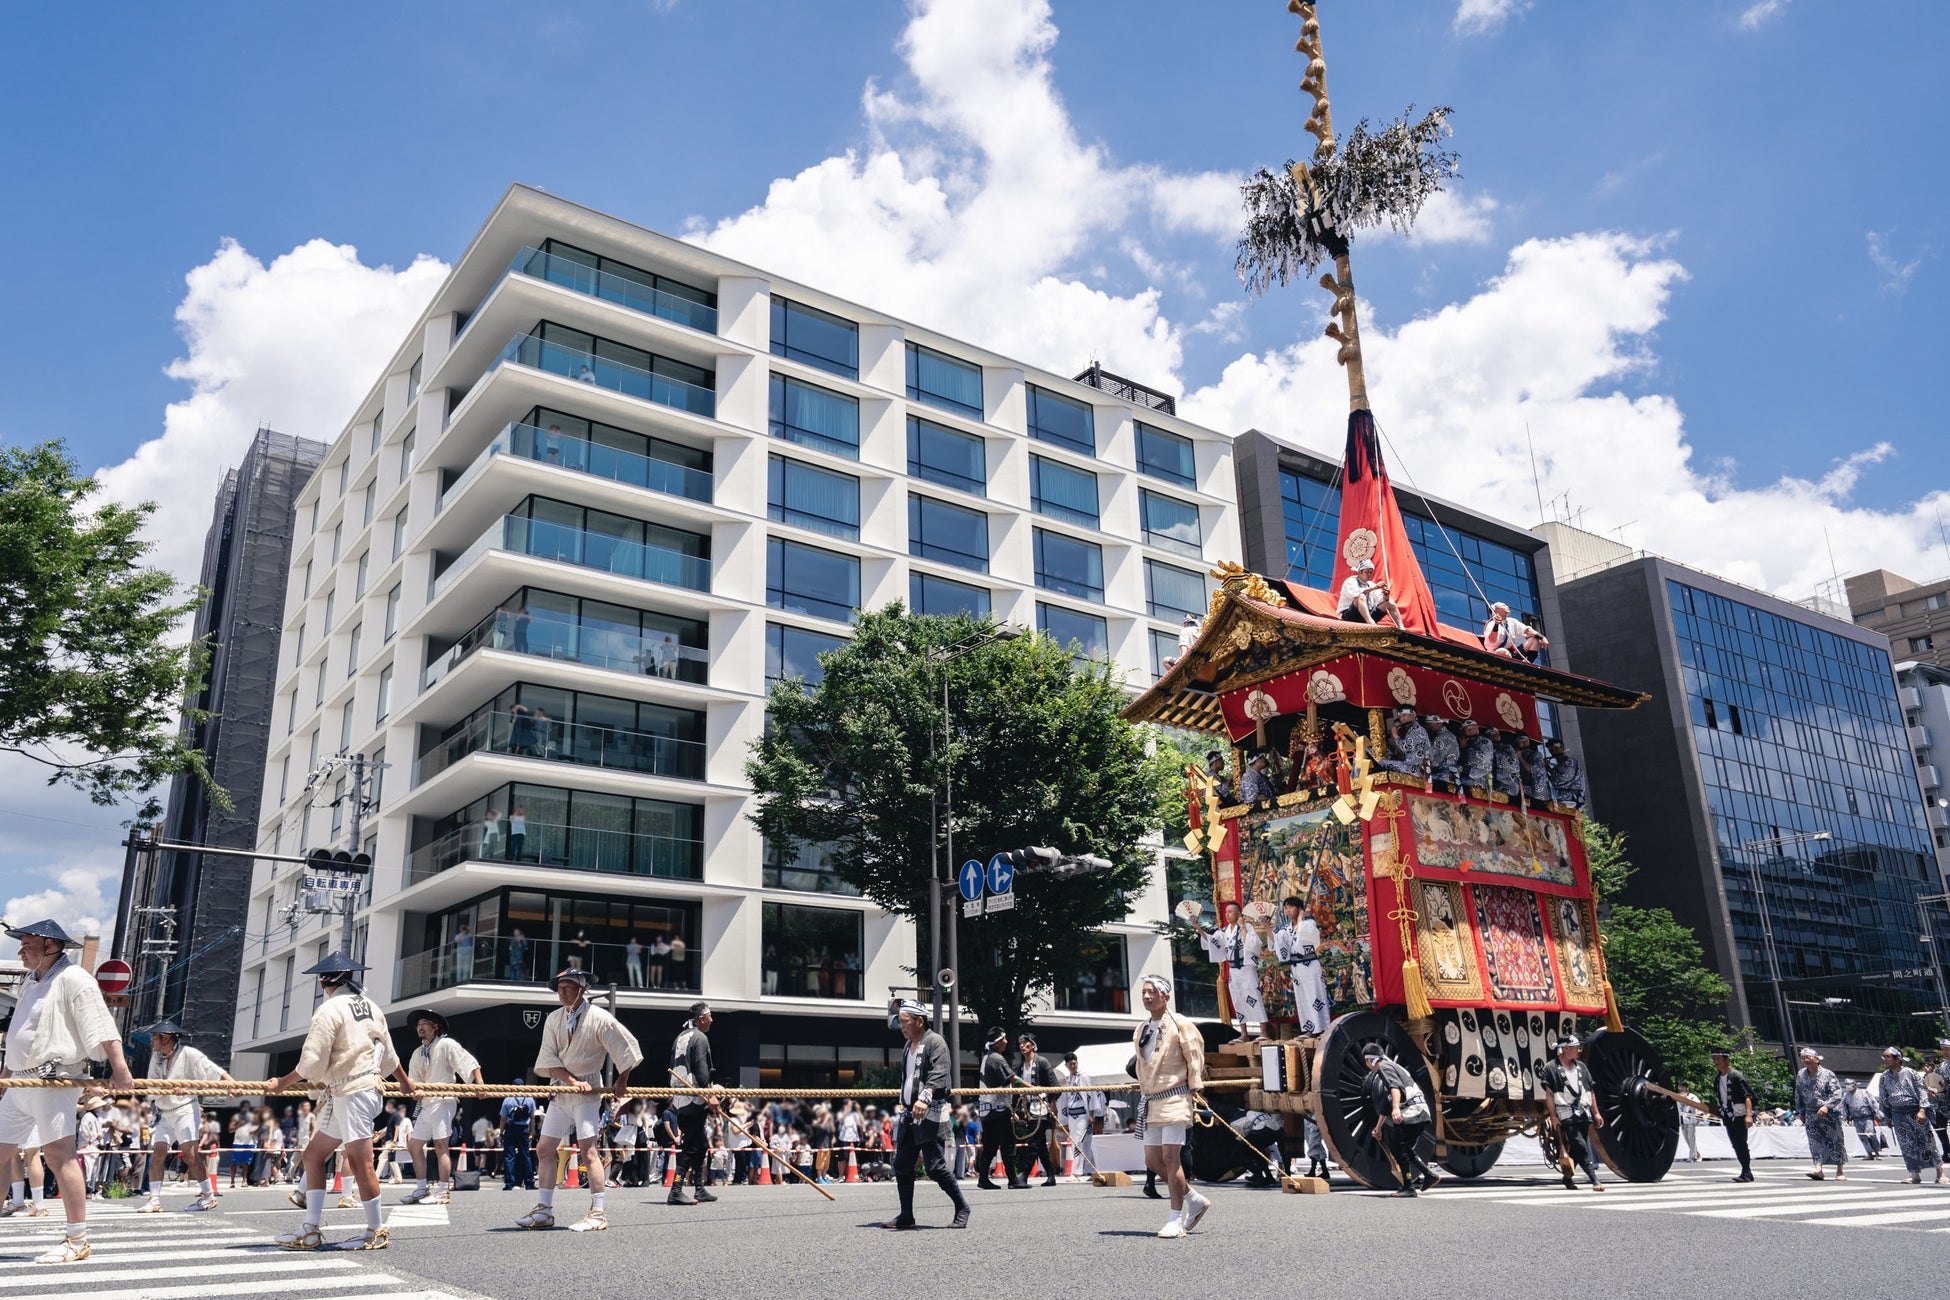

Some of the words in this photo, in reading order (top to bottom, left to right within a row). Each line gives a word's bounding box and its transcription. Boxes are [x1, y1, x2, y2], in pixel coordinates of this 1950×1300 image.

[305, 877, 361, 894] 自転車専用
